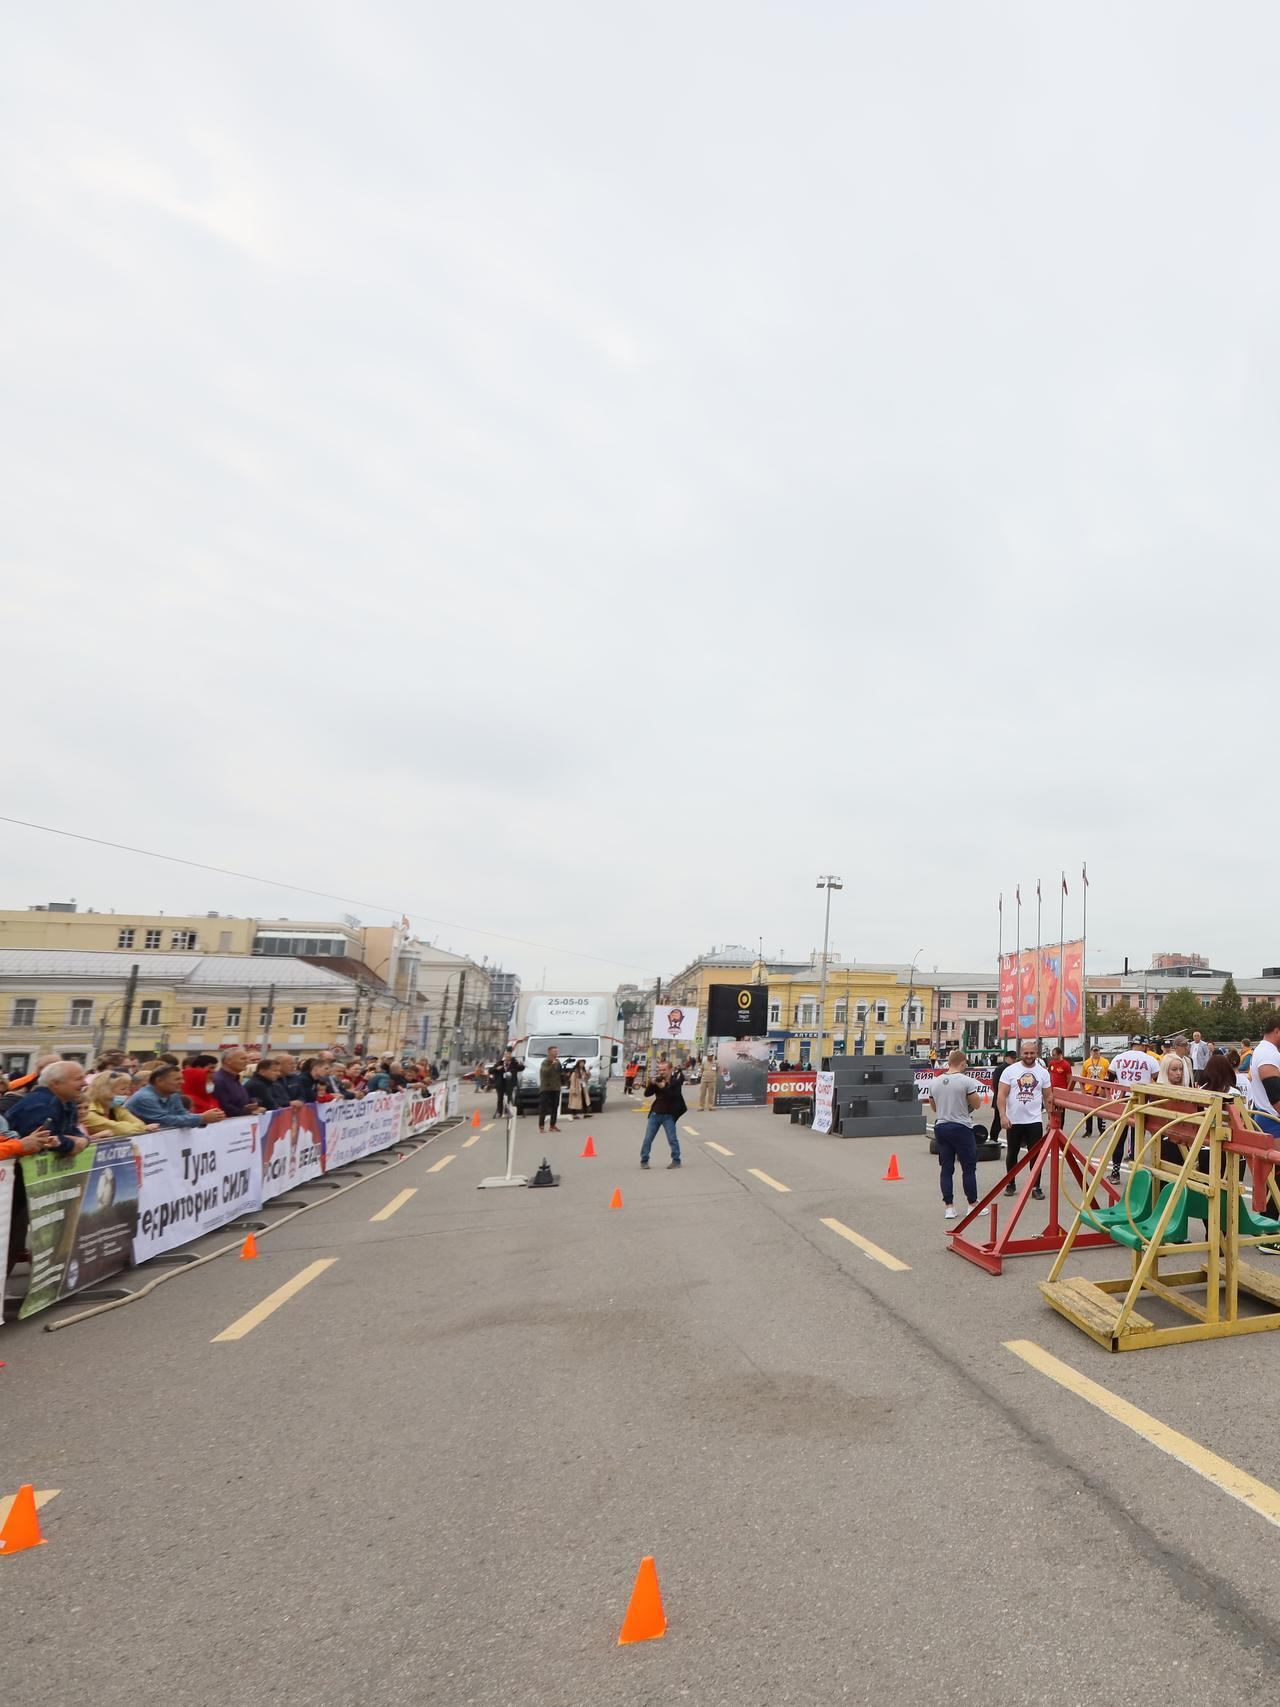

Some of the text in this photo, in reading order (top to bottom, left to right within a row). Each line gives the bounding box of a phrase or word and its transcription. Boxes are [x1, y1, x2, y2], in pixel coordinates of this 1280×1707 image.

[547, 998, 589, 1006] 25-05-05
[1116, 1059, 1148, 1071] ТУЛА
[915, 1071, 991, 1080] СИЯ ПЕРЕД
[1121, 1071, 1142, 1081] 875
[182, 1148, 217, 1186] Тула
